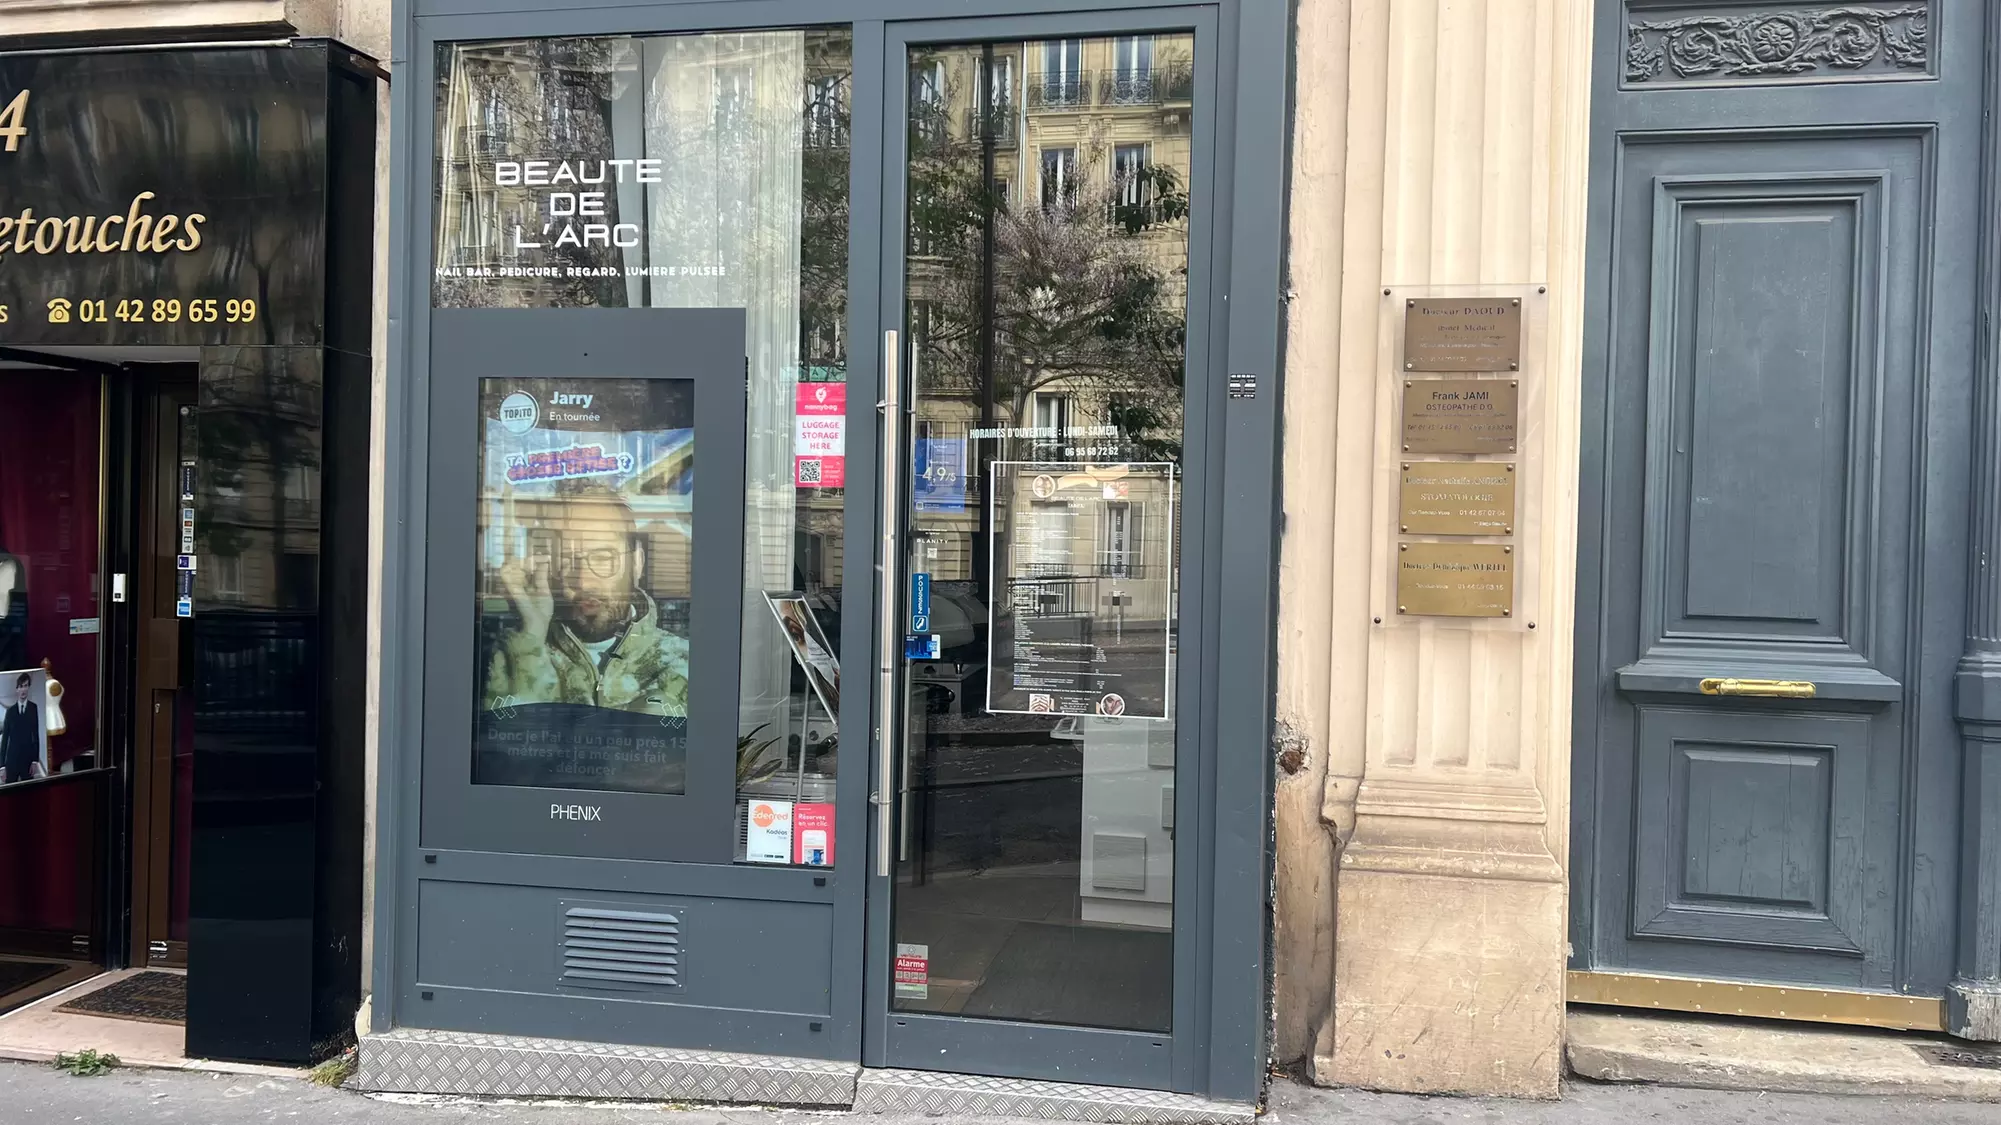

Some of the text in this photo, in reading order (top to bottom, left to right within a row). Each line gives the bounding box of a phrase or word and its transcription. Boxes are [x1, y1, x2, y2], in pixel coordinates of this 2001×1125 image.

[495, 159, 662, 186] BEAUTE
[550, 192, 605, 216] DE
[515, 223, 640, 249] L'ARC
[435, 265, 726, 278] NAIL BAR, PEDICURE, REGARD, LUMIERE PULSEE
[79, 300, 108, 323] 01
[115, 300, 144, 323] 42
[151, 300, 181, 323] 89
[188, 300, 218, 323] 65
[225, 300, 256, 323] 99
[550, 391, 593, 408] Jarry
[1432, 391, 1489, 400] Frank JAMI
[503, 407, 533, 419] TOPITO
[550, 411, 600, 422] En tournée
[802, 421, 840, 429] LUGGAGE
[969, 427, 1005, 439] HORAIRES
[1007, 427, 1057, 439] D'OUVERTURE
[1064, 425, 1119, 438] LUNDI-SAMEDI
[1064, 448, 1074, 457] 06
[1076, 448, 1085, 456] 95
[507, 456, 525, 467] TA
[488, 728, 522, 742] Donc
[523, 730, 538, 744] je
[635, 735, 666, 750] près
[669, 736, 687, 750] 15
[572, 748, 585, 761] je
[613, 750, 641, 763] suis
[643, 750, 667, 764] fait
[550, 803, 601, 821] PHENIX
[798, 813, 826, 821] Réservez
[897, 959, 926, 967] Alarme
